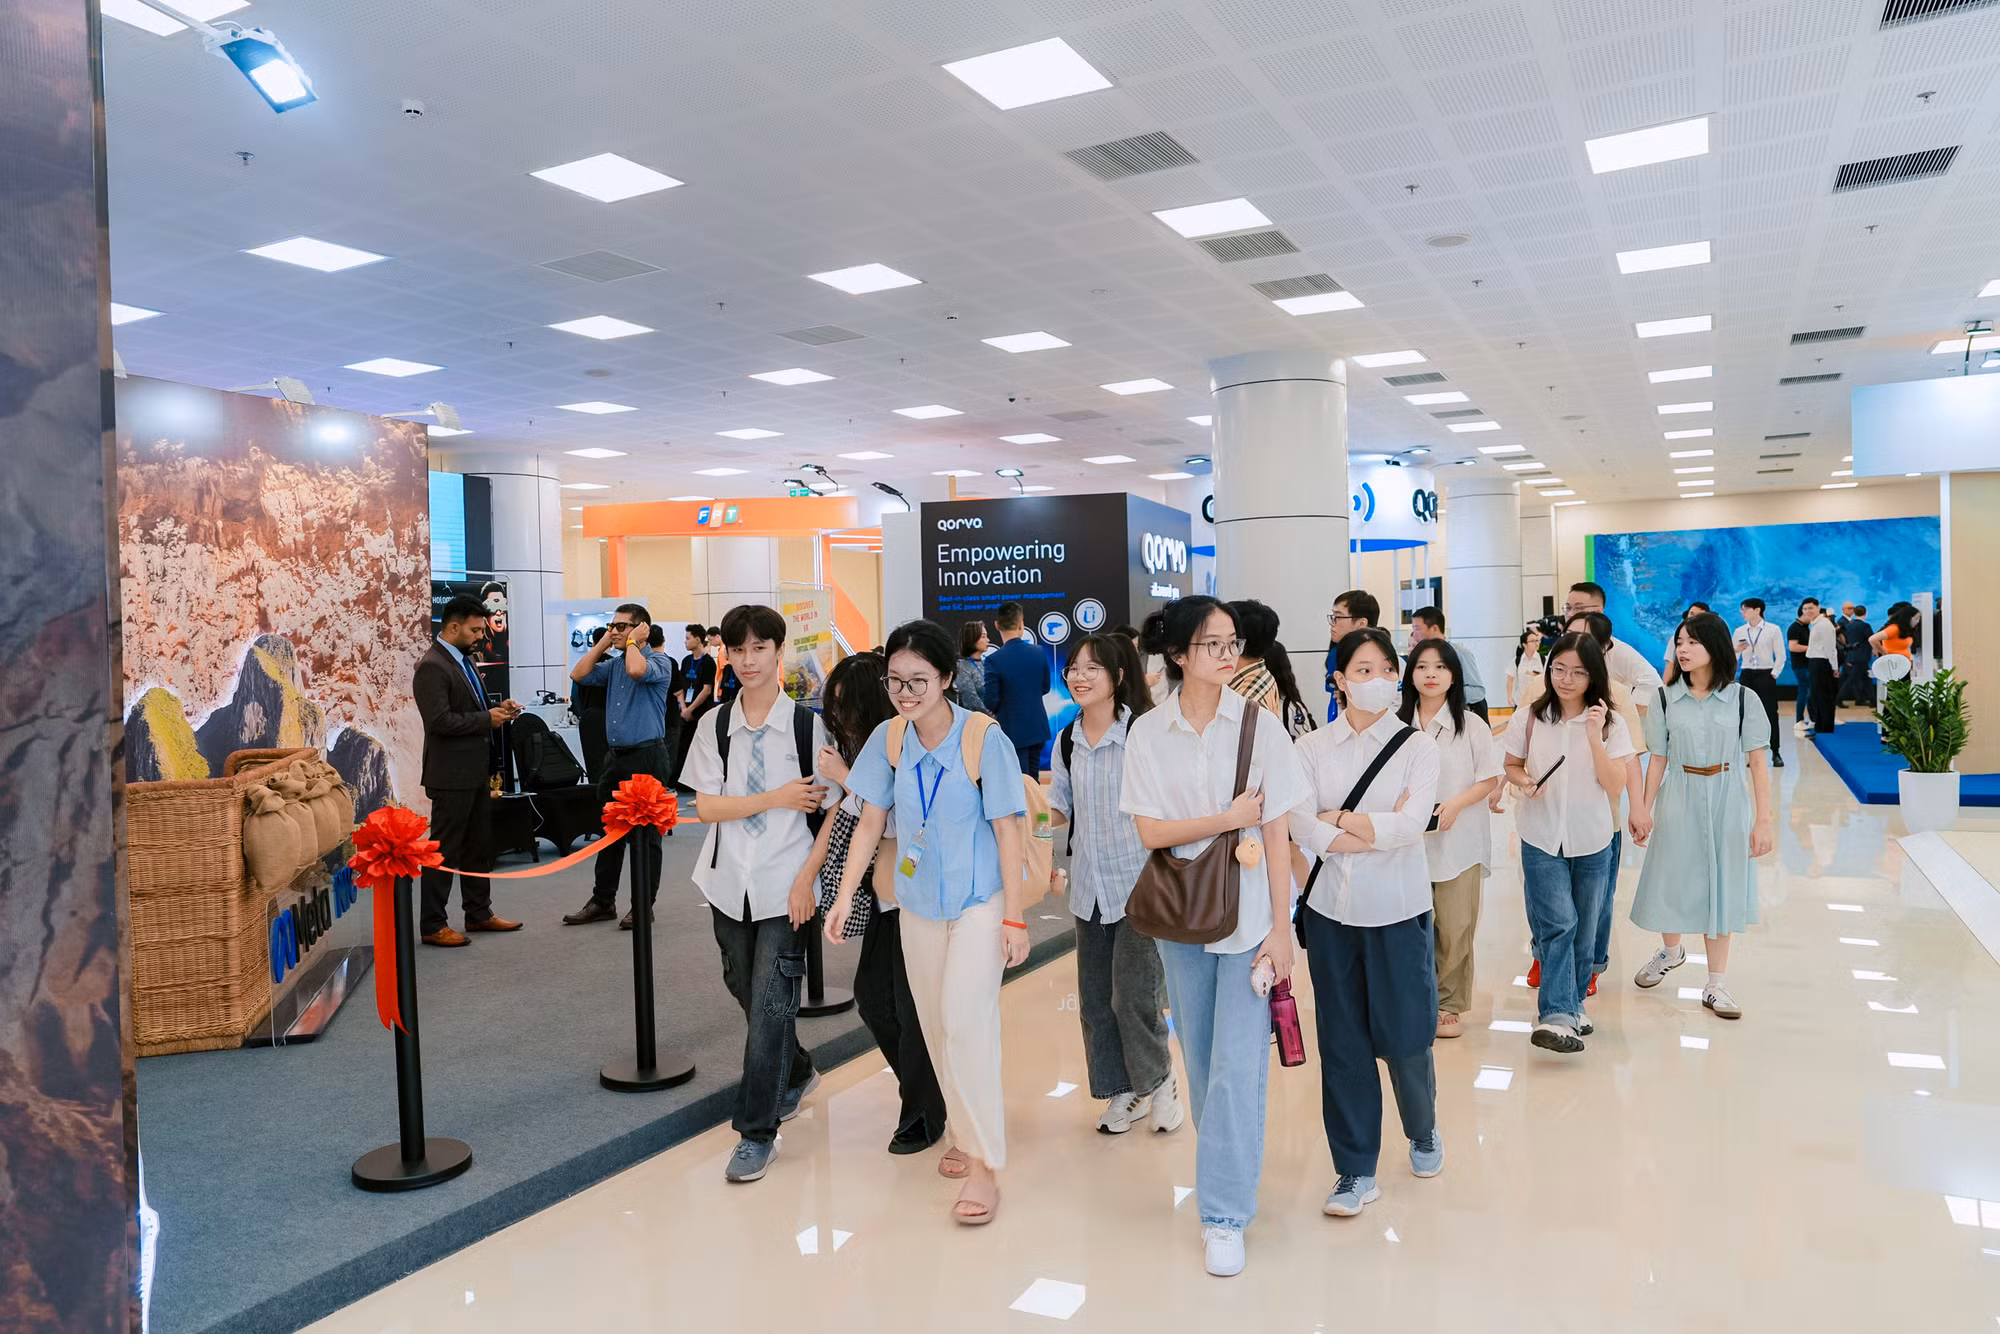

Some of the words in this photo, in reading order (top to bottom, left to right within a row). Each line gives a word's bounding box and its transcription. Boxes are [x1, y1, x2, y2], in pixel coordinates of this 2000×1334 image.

[937, 540, 1065, 566] Empowering
[937, 564, 1042, 587] Innovation
[289, 885, 332, 963] Meta
